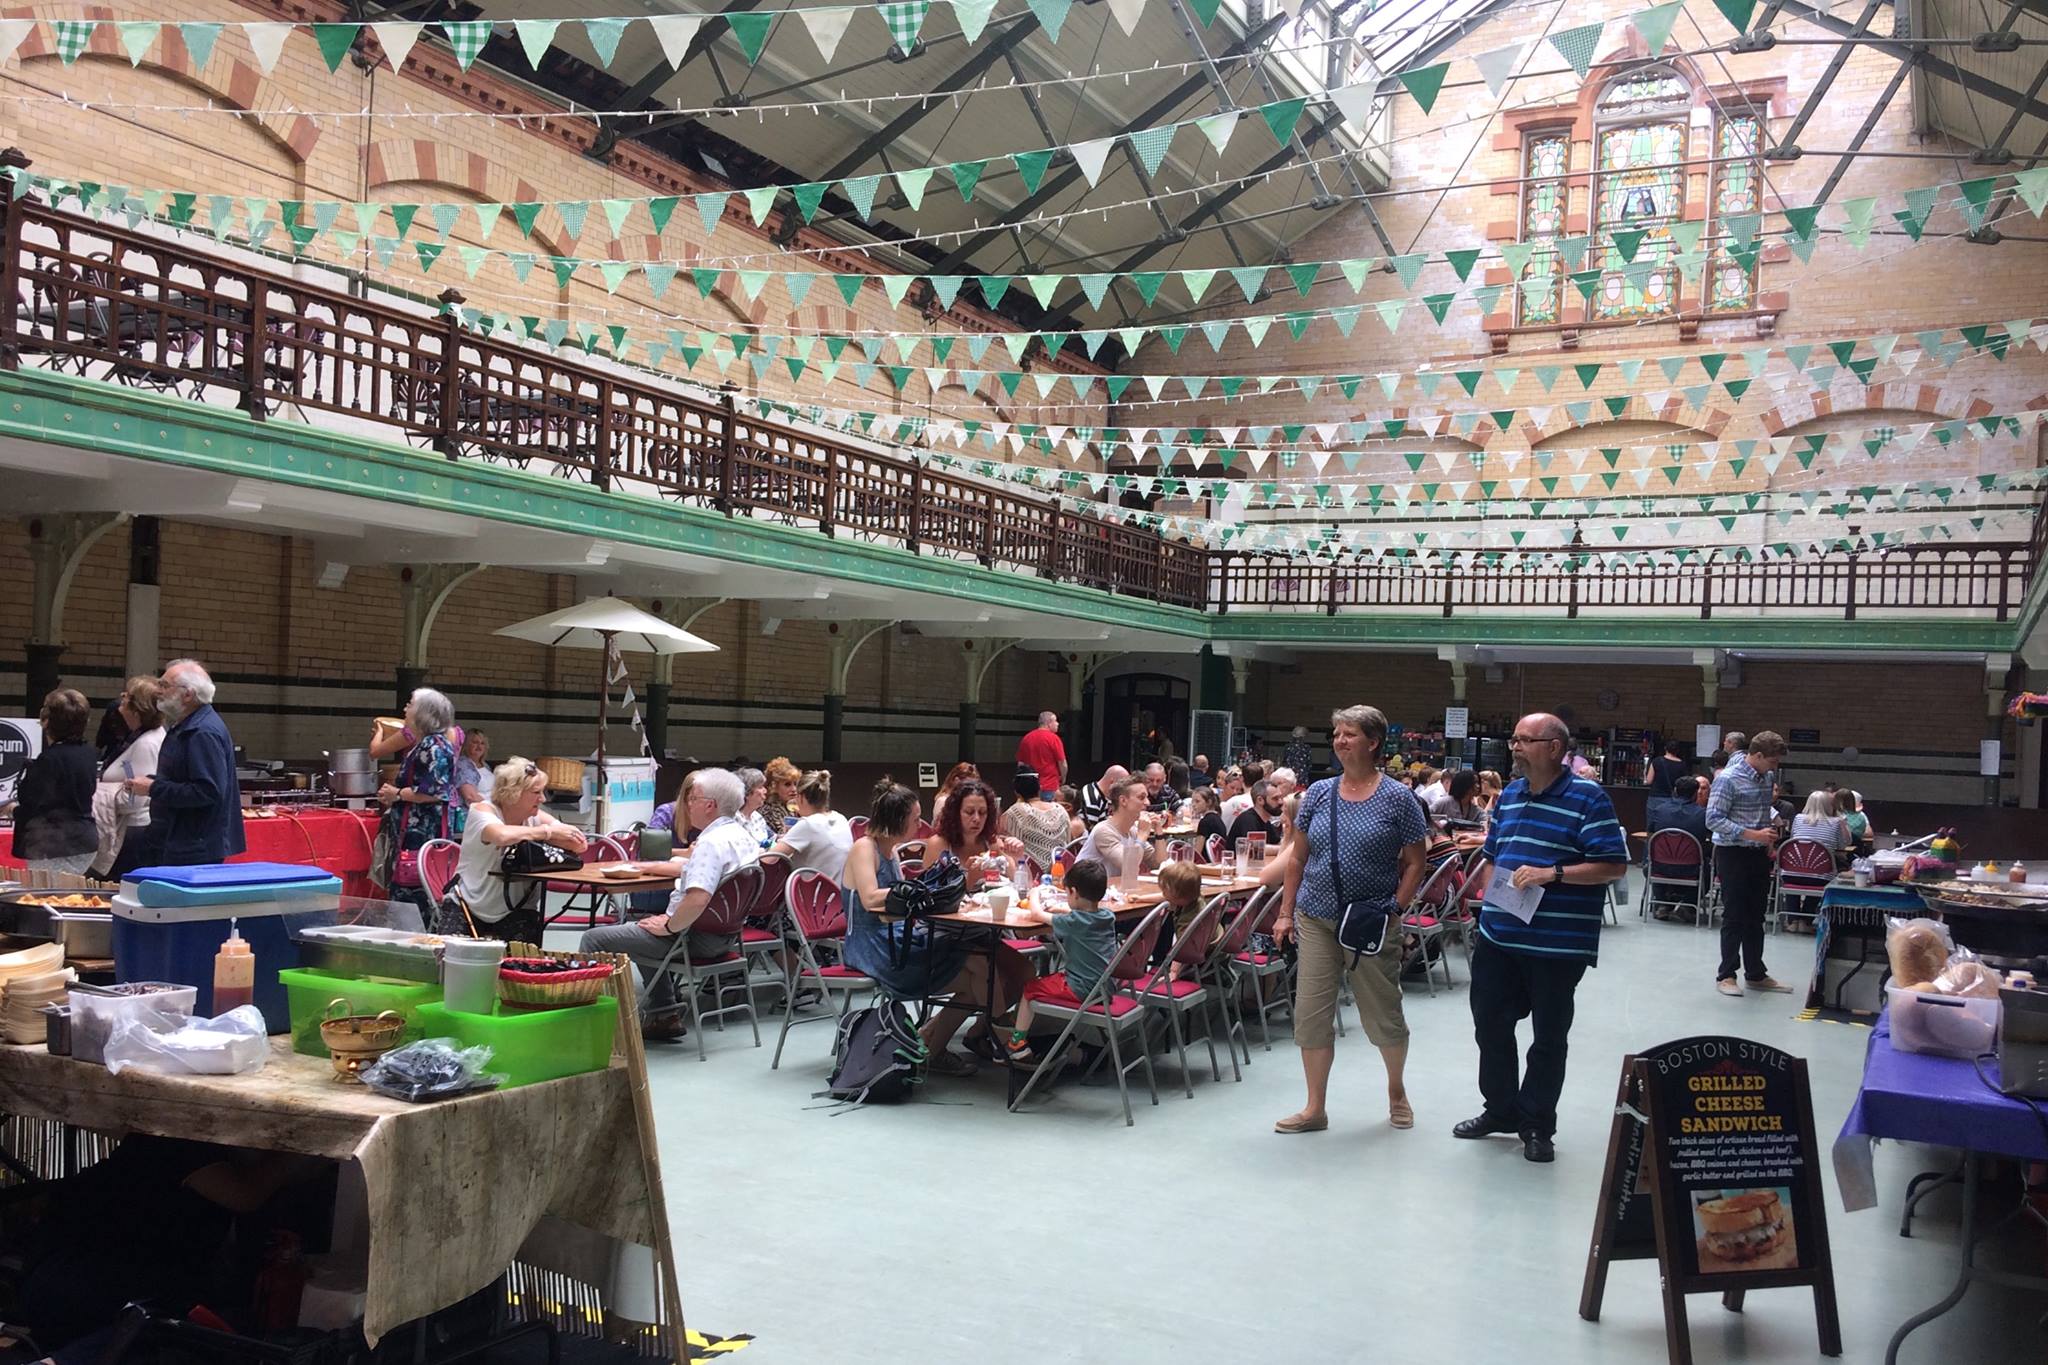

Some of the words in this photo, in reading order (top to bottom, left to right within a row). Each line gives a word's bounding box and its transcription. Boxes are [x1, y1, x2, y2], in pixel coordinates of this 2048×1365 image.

[1657, 1042, 1731, 1075] BOSTON
[1740, 1043, 1788, 1071] STYLE
[1688, 1075, 1767, 1092] GRILLED
[1695, 1096, 1765, 1112] CHEESE
[1681, 1115, 1783, 1133] SANDWICH
[1716, 1135, 1724, 1145] of
[1747, 1135, 1766, 1144] bread
[1738, 1146, 1761, 1155] chicken
[1762, 1145, 1775, 1154] and
[1727, 1158, 1741, 1168] and
[1766, 1169, 1778, 1178] the
